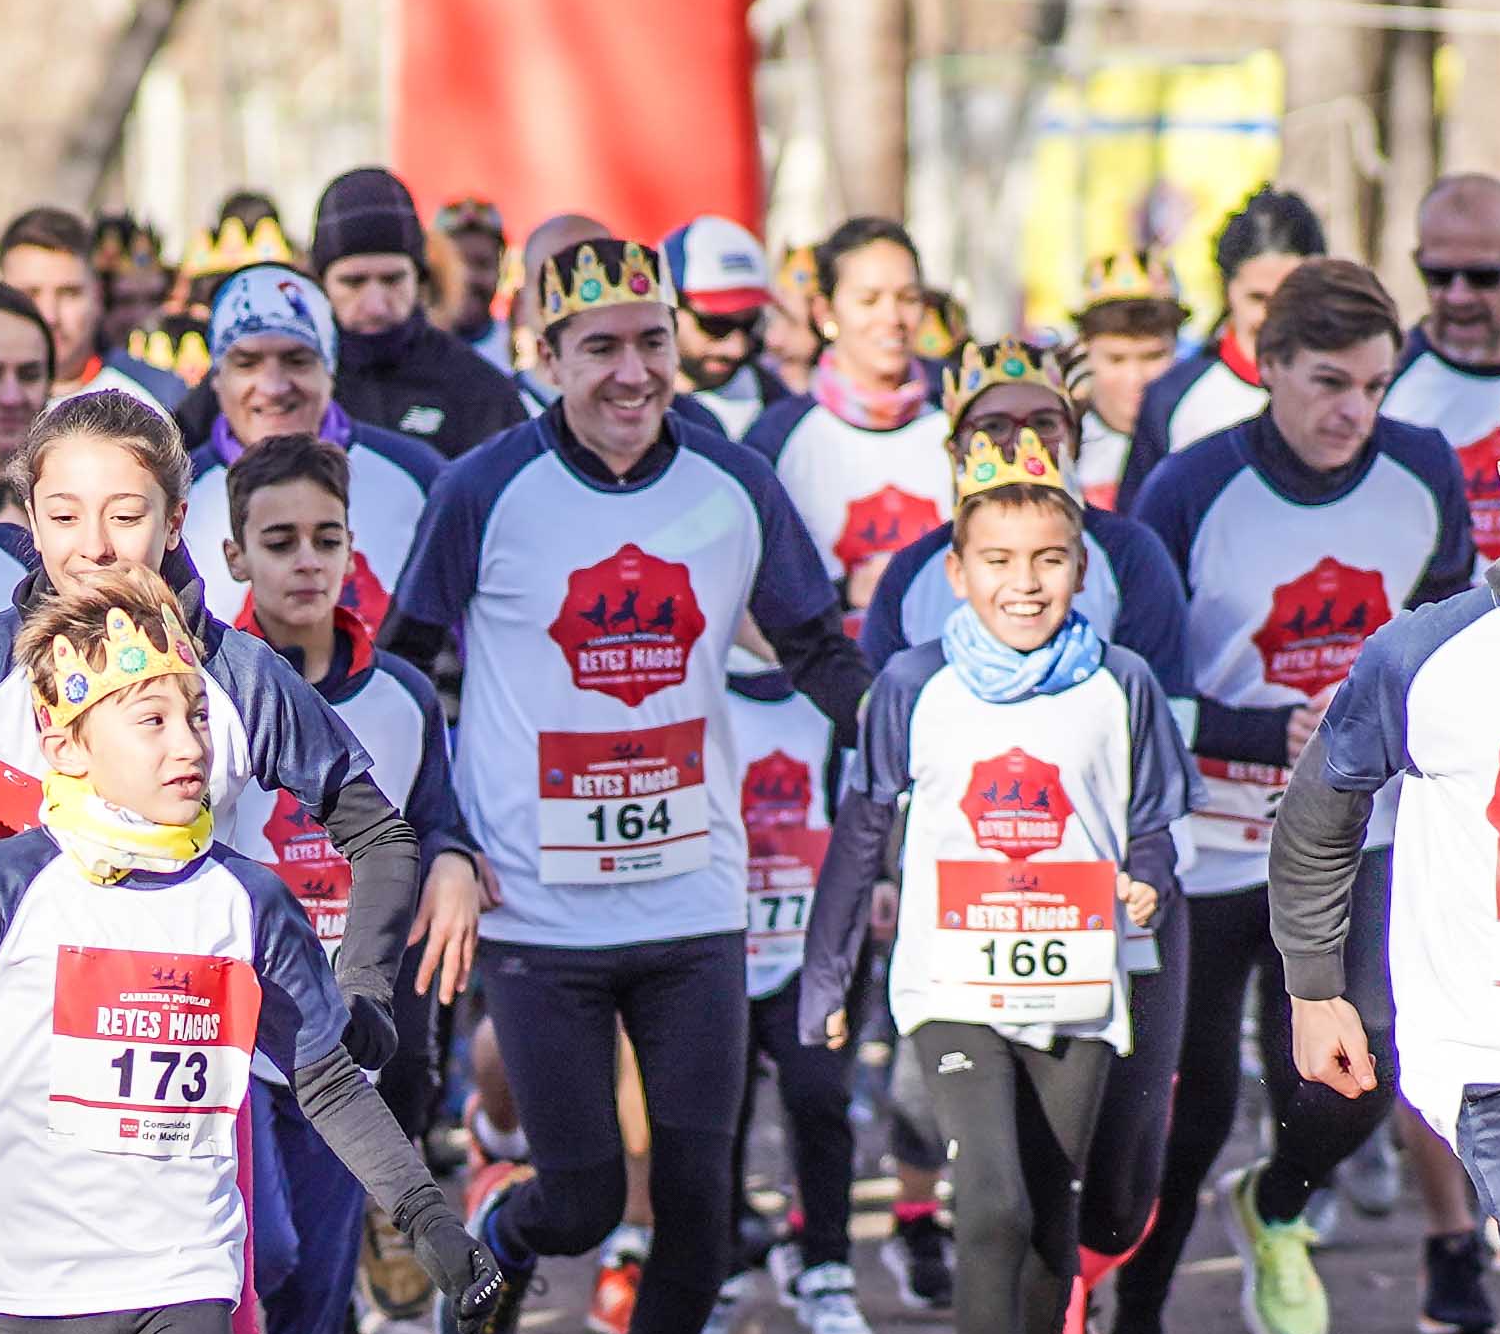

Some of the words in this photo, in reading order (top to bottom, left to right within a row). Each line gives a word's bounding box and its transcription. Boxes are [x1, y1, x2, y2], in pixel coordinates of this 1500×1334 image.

[587, 798, 672, 842] 164
[760, 894, 807, 930] 77
[980, 939, 1068, 977] 166
[119, 992, 170, 1003] CARRERA
[172, 994, 211, 1008] POPULAR
[96, 1006, 162, 1039] REYES
[168, 1012, 221, 1041] MAGOS
[111, 1048, 208, 1102] 173
[142, 1132, 156, 1141] de
[159, 1131, 190, 1142] Madrid
[143, 1119, 191, 1130] Comunidad
